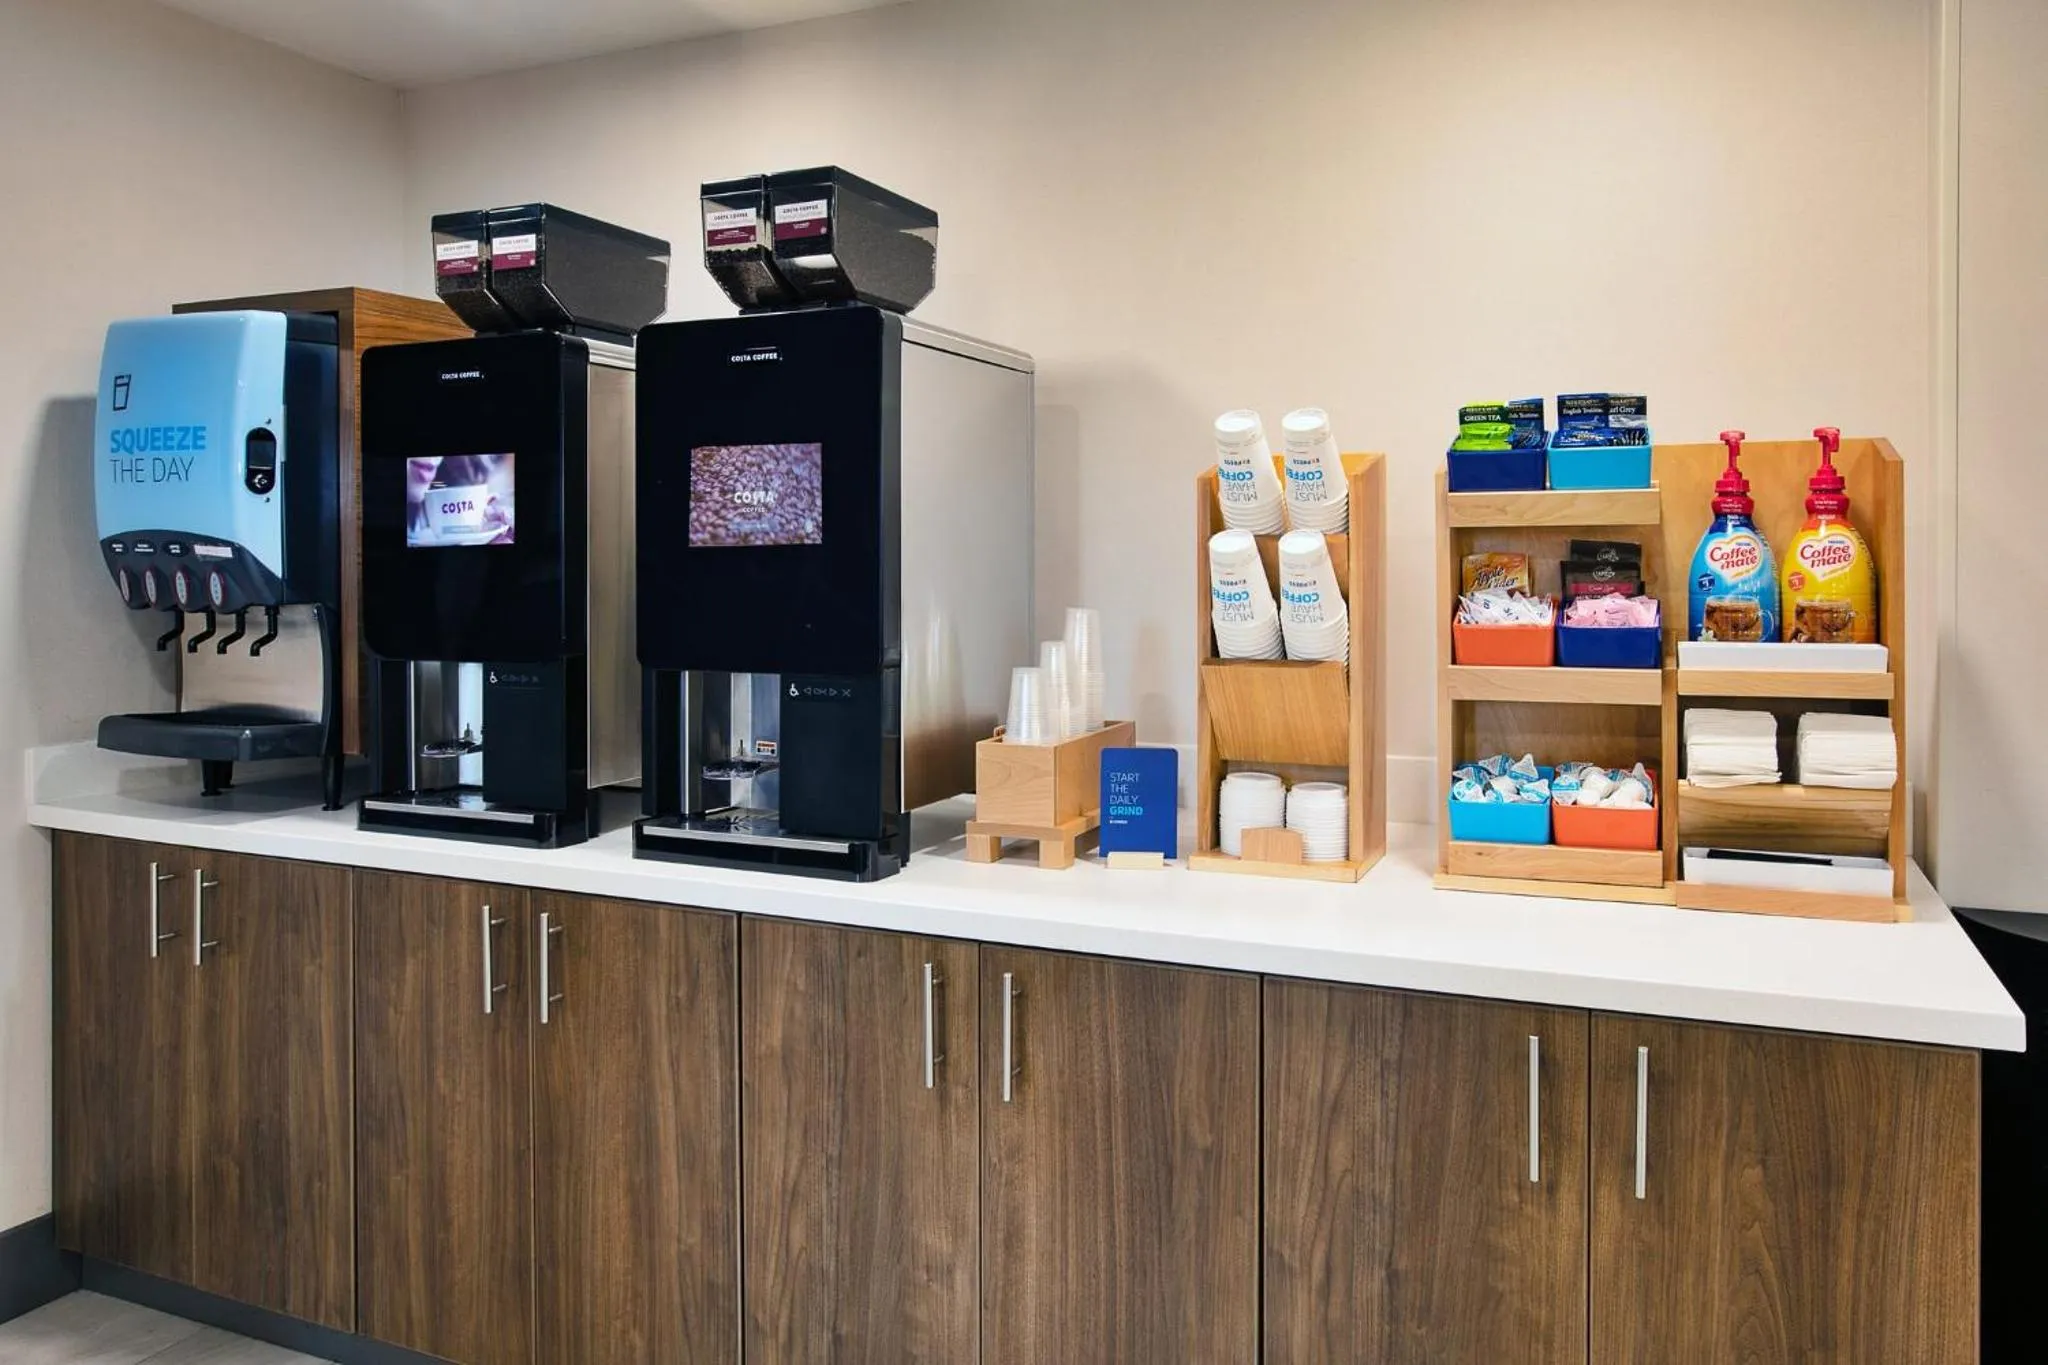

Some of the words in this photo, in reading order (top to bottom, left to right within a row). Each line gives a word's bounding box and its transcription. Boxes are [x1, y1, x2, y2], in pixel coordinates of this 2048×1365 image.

[752, 352, 778, 361] COFFEE
[110, 426, 207, 454] SQUEEZE
[110, 458, 144, 483] THE
[152, 456, 195, 483] DAY
[1224, 481, 1256, 491] HAVE
[1295, 480, 1325, 491] HAVE
[734, 491, 775, 505] COSTA
[1226, 491, 1258, 502] MUST
[1295, 491, 1328, 502] MUST
[441, 501, 474, 514] COSTA
[1710, 546, 1756, 562] Coffee
[1800, 544, 1850, 560] Coffee
[1720, 555, 1757, 570] mate
[1811, 553, 1851, 568] mate
[1110, 772, 1140, 782] START
[1110, 783, 1129, 794] THE
[1109, 795, 1139, 805] DAILY
[1109, 806, 1144, 816] GRIND
